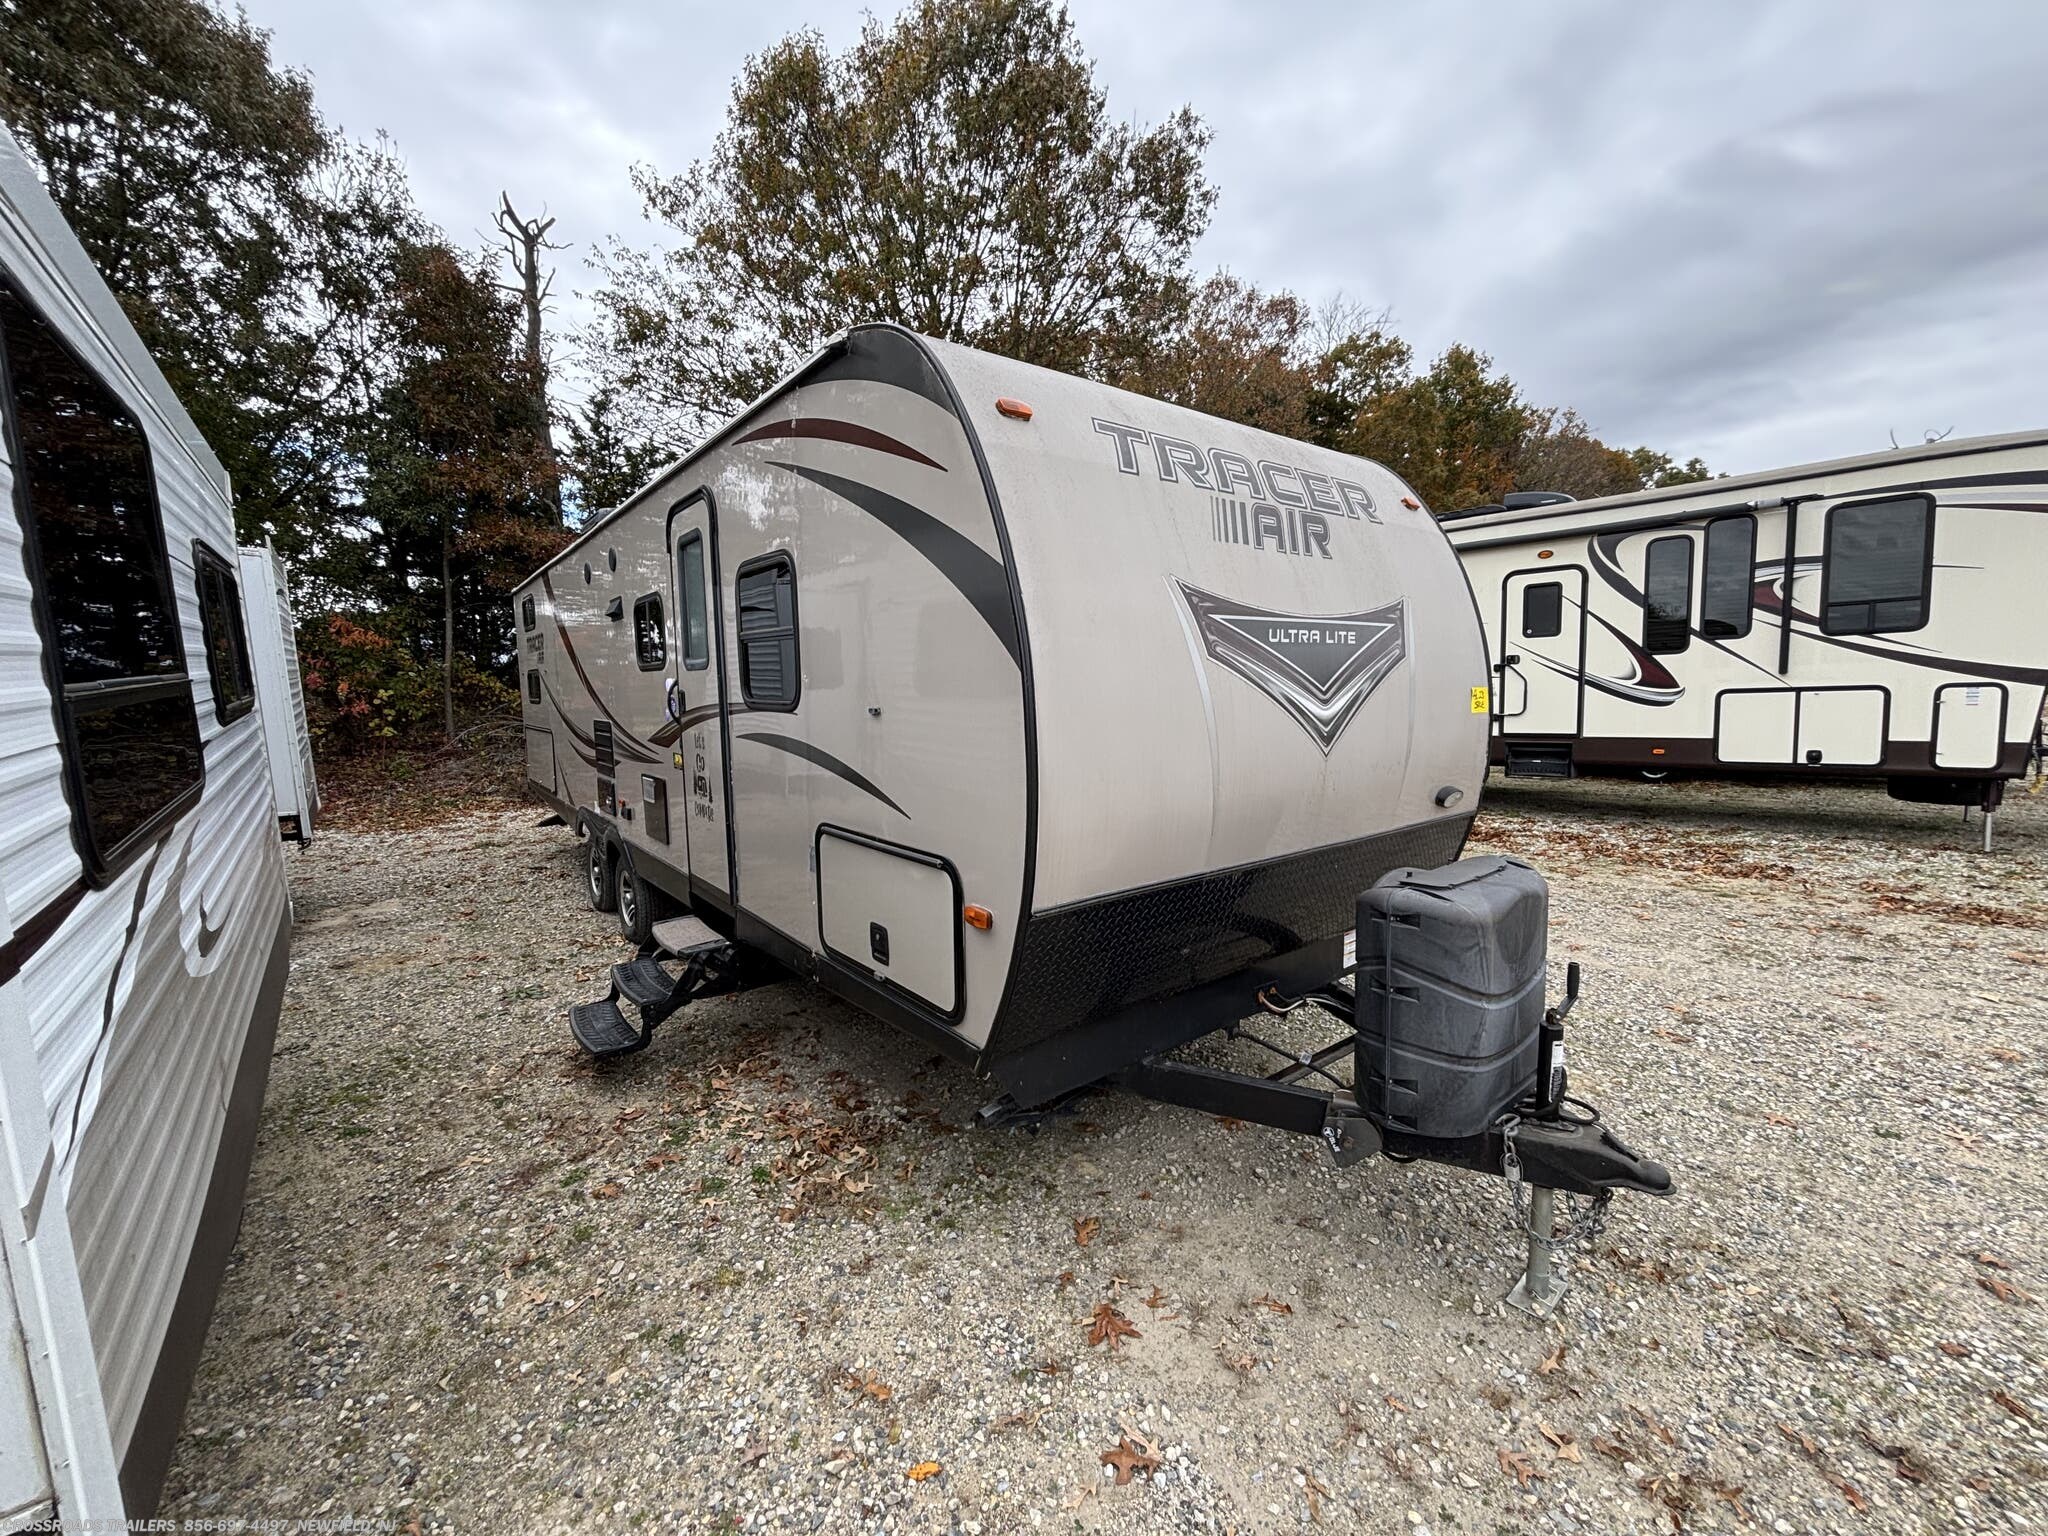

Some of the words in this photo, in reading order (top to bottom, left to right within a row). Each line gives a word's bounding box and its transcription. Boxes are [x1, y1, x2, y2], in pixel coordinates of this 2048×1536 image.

[1091, 417, 1384, 525] TRACER
[1250, 502, 1333, 560] AIR
[1267, 628, 1320, 644] ULTRA
[1325, 630, 1357, 645] LITE
